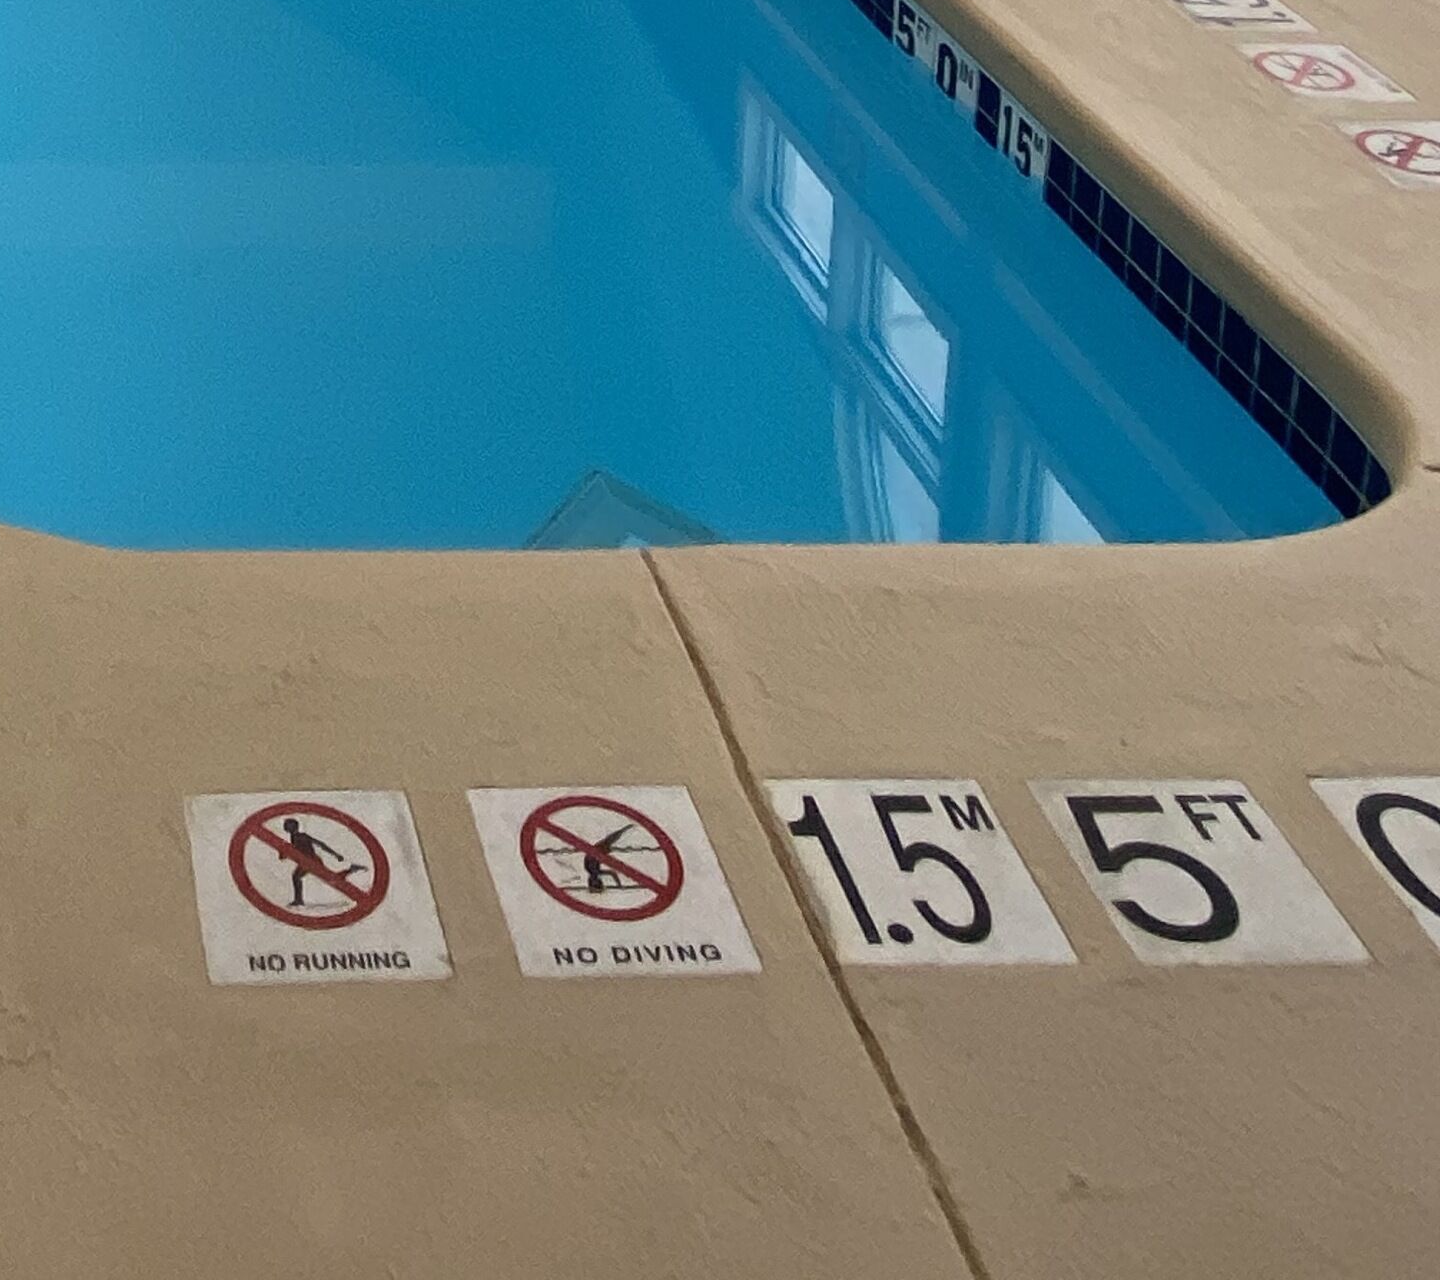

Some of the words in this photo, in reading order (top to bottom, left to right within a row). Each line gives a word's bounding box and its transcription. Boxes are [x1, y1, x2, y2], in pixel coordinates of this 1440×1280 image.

[248, 952, 287, 973] NO
[293, 951, 411, 972] RUNNING
[553, 946, 598, 966] NO
[611, 944, 722, 965] DIVING
